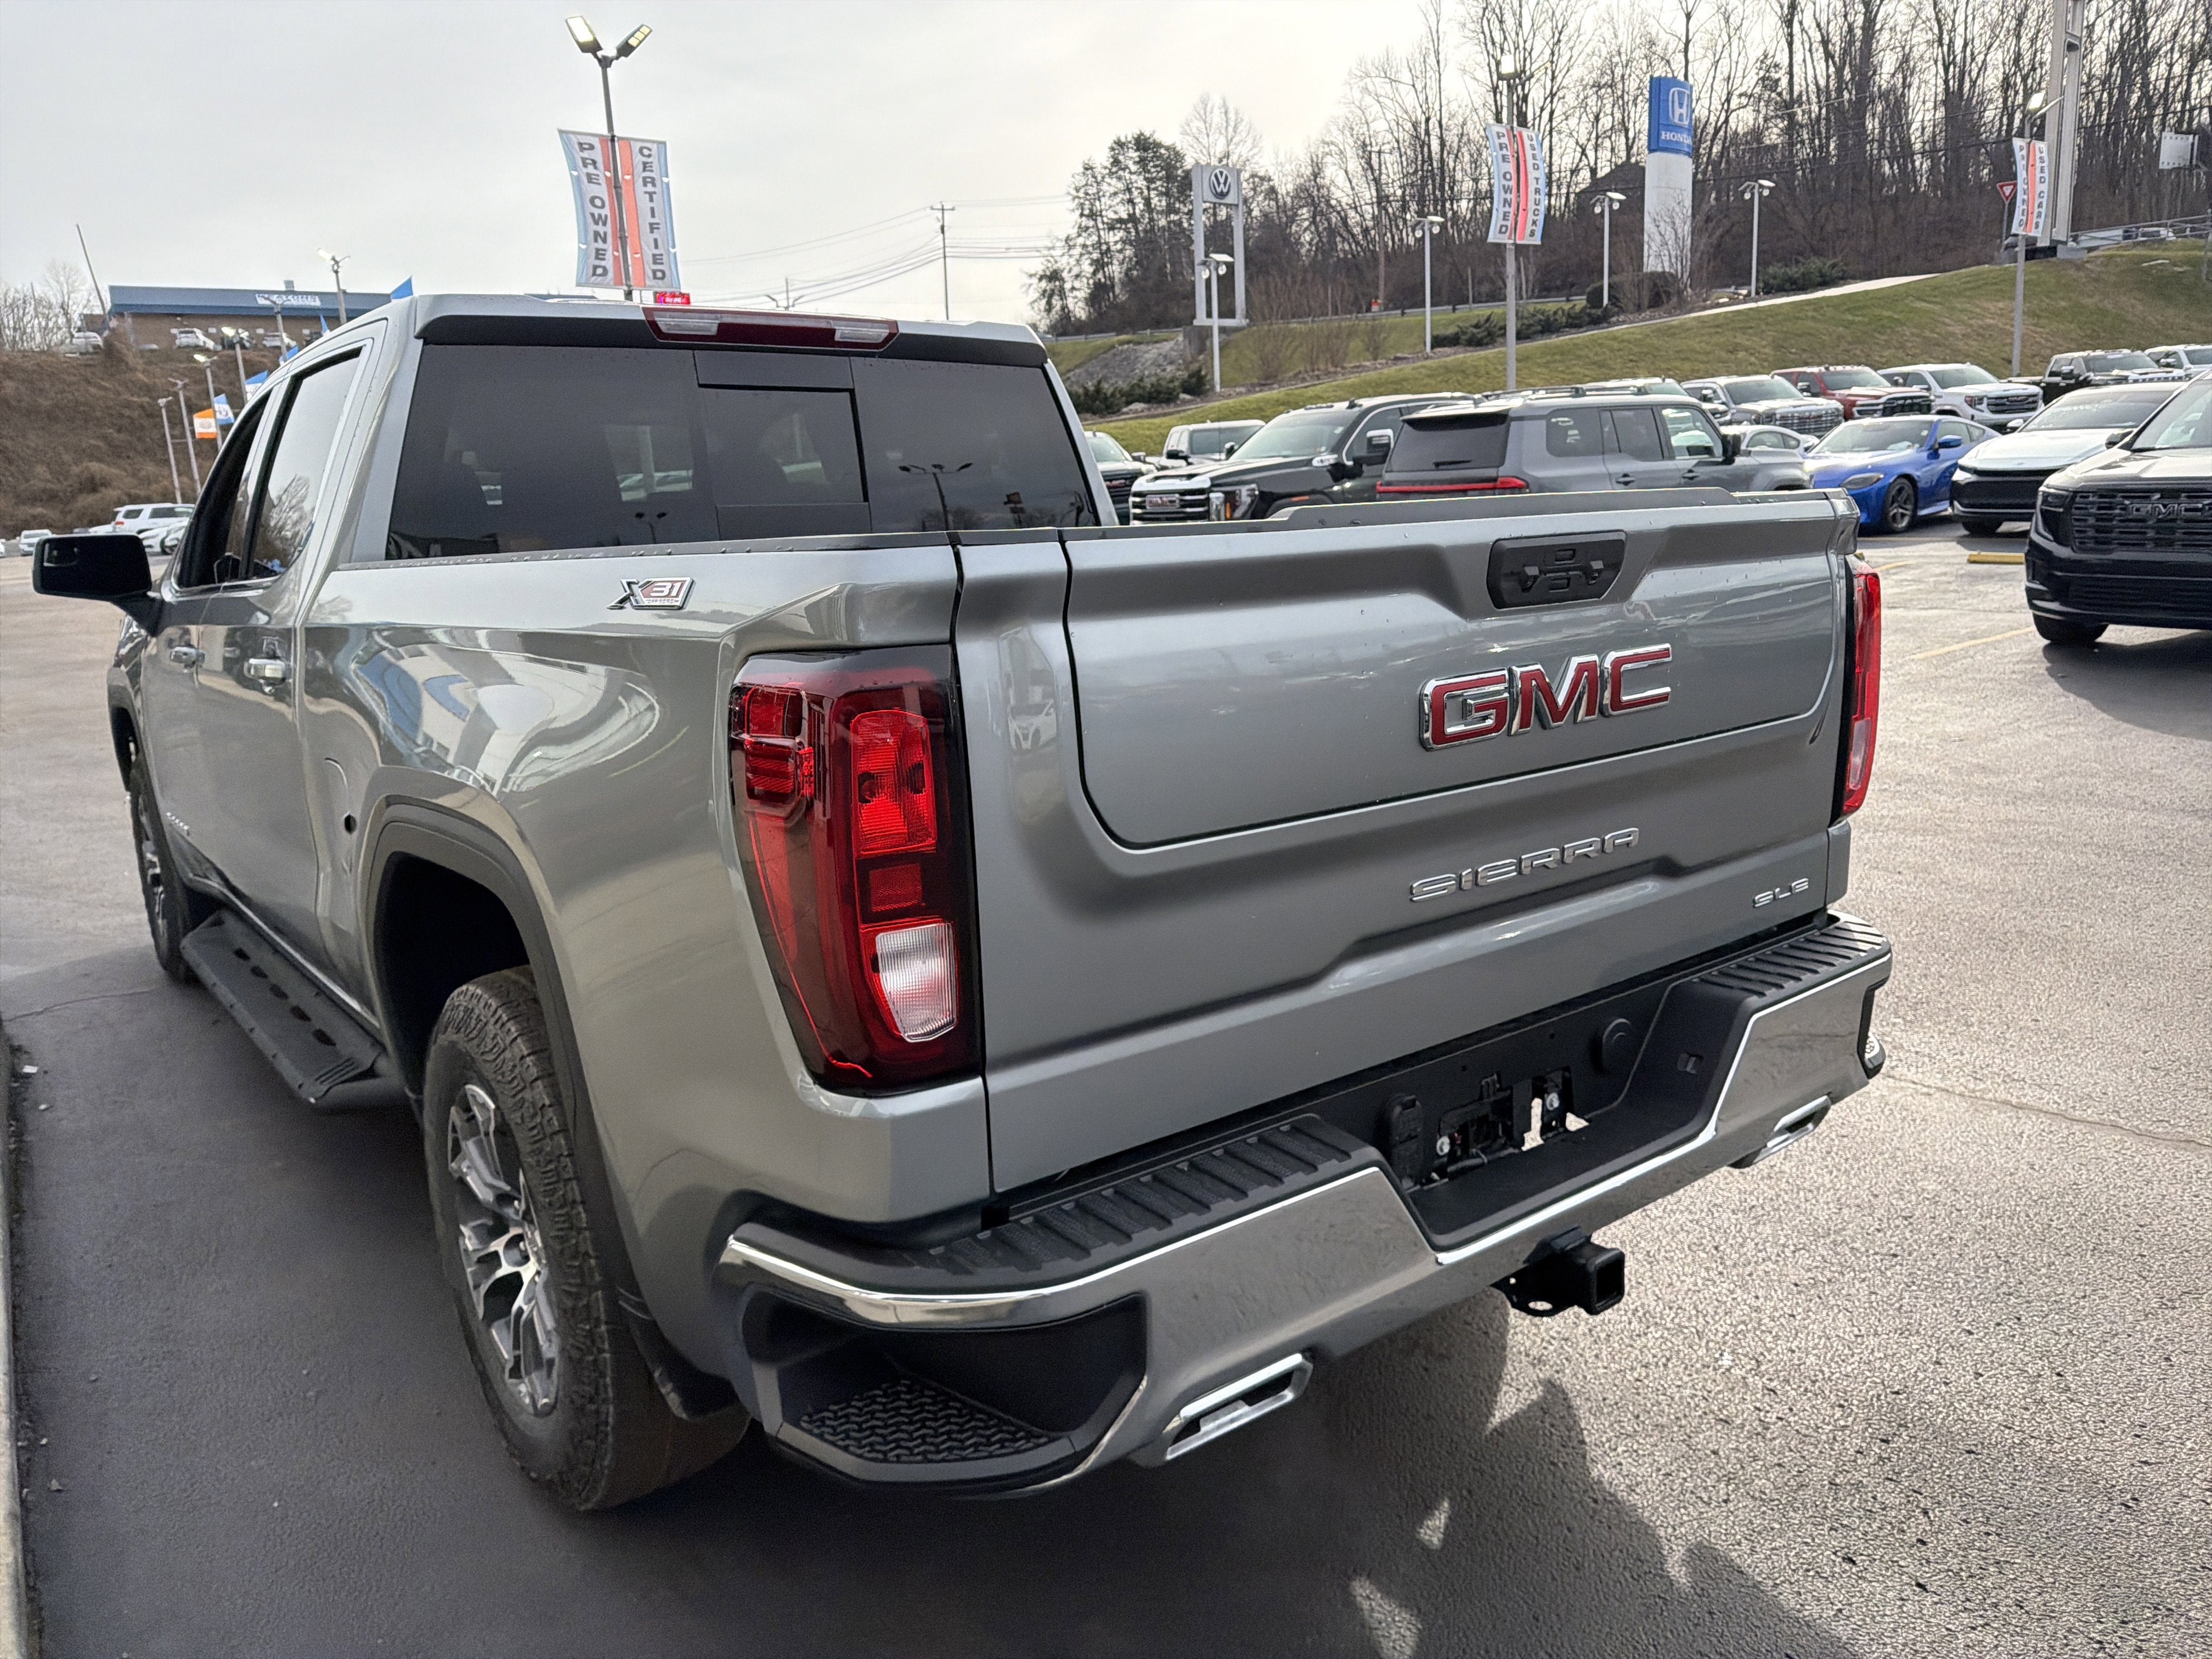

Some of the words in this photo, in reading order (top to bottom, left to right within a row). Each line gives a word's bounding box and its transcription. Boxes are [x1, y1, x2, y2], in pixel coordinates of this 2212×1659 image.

[1497, 132, 1510, 162] PRE
[1527, 134, 1539, 171] USED
[1661, 131, 1693, 145] HONDA
[578, 142, 601, 185] PRE
[2038, 146, 2046, 184] USED
[638, 145, 667, 281] CERTIFIED
[1498, 171, 1513, 235] OWNED
[1528, 177, 1541, 238] TRUCKS
[2035, 190, 2045, 230] CARS
[589, 195, 608, 278] OWNED
[2131, 503, 2203, 518] GMC
[606, 577, 694, 610] X31
[1420, 643, 1672, 751] GMC
[1409, 827, 1640, 902] SIERRA
[1753, 878, 1809, 908] SLE
